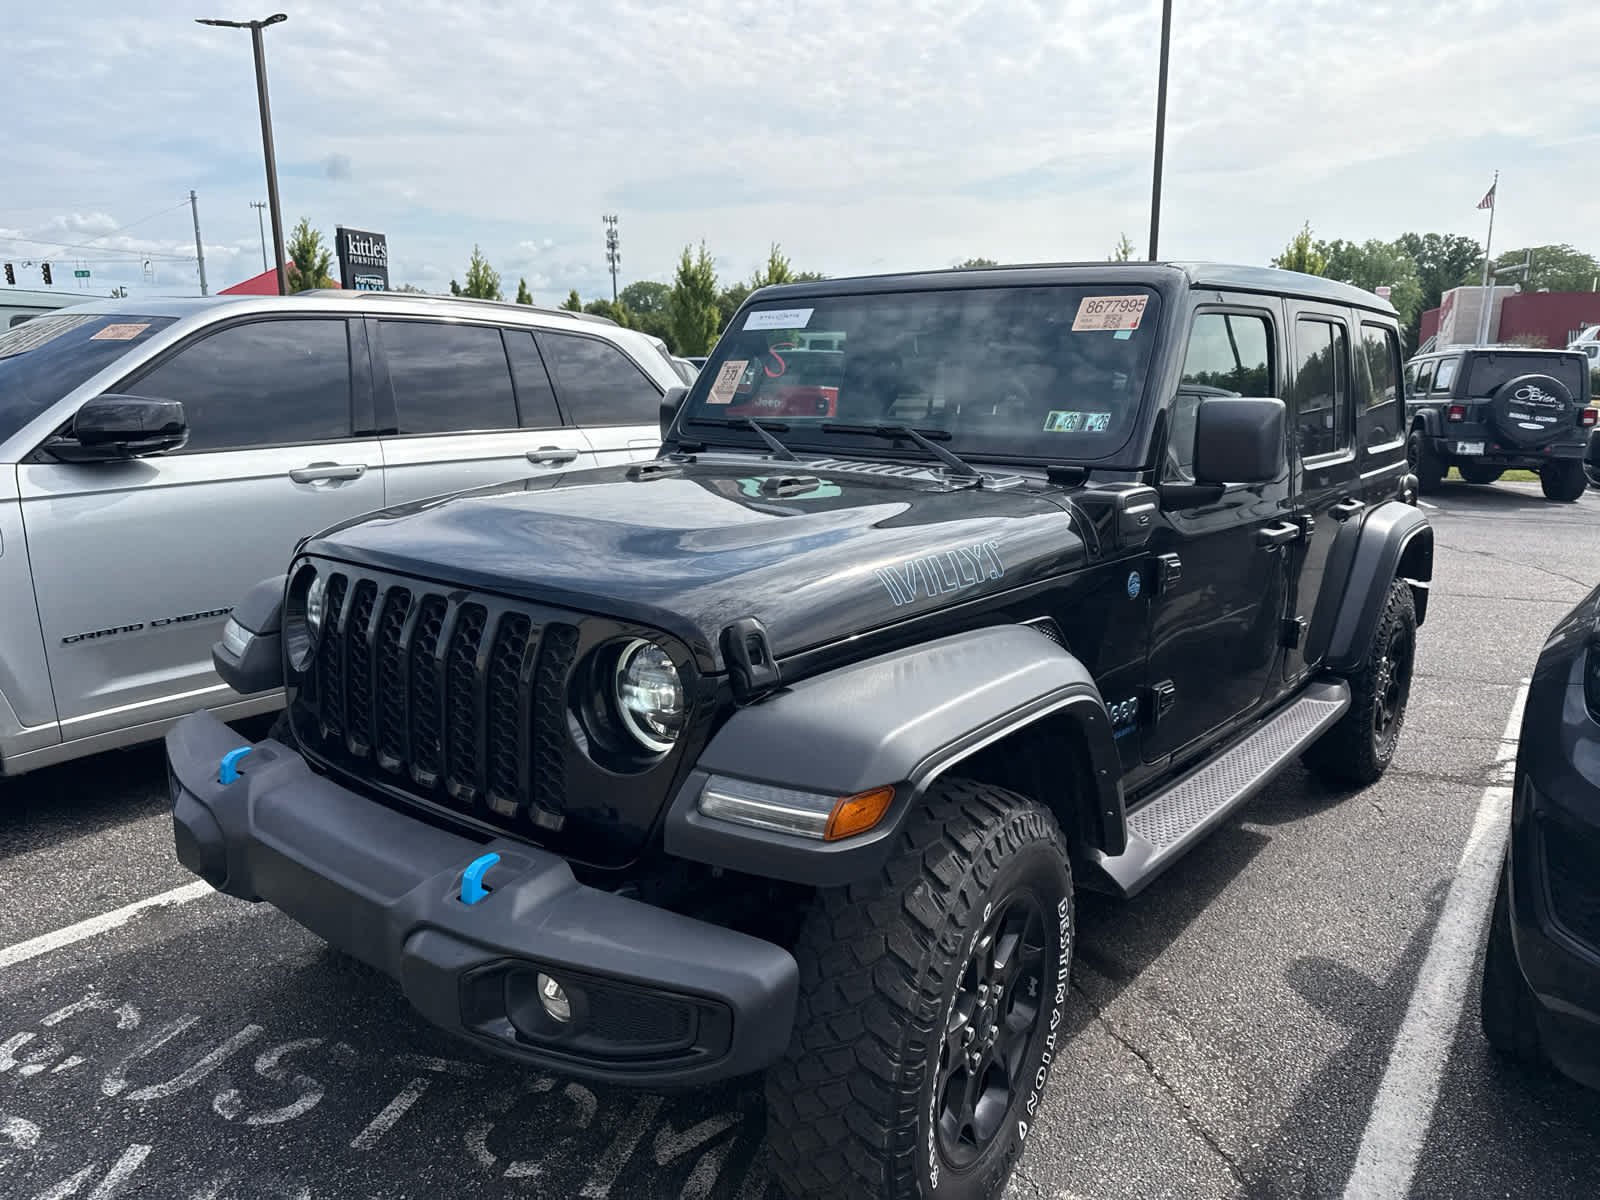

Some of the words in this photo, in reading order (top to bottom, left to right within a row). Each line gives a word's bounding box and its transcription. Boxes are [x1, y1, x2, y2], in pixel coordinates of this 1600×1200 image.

[347, 233, 387, 258] kittle's
[349, 255, 387, 267] FURNITURE
[1086, 298, 1146, 314] 8677995
[875, 539, 1005, 606] WILLYS
[62, 622, 144, 644] GRAND
[150, 607, 235, 627] CHEROK
[1027, 897, 1069, 1117] DESTINATION
